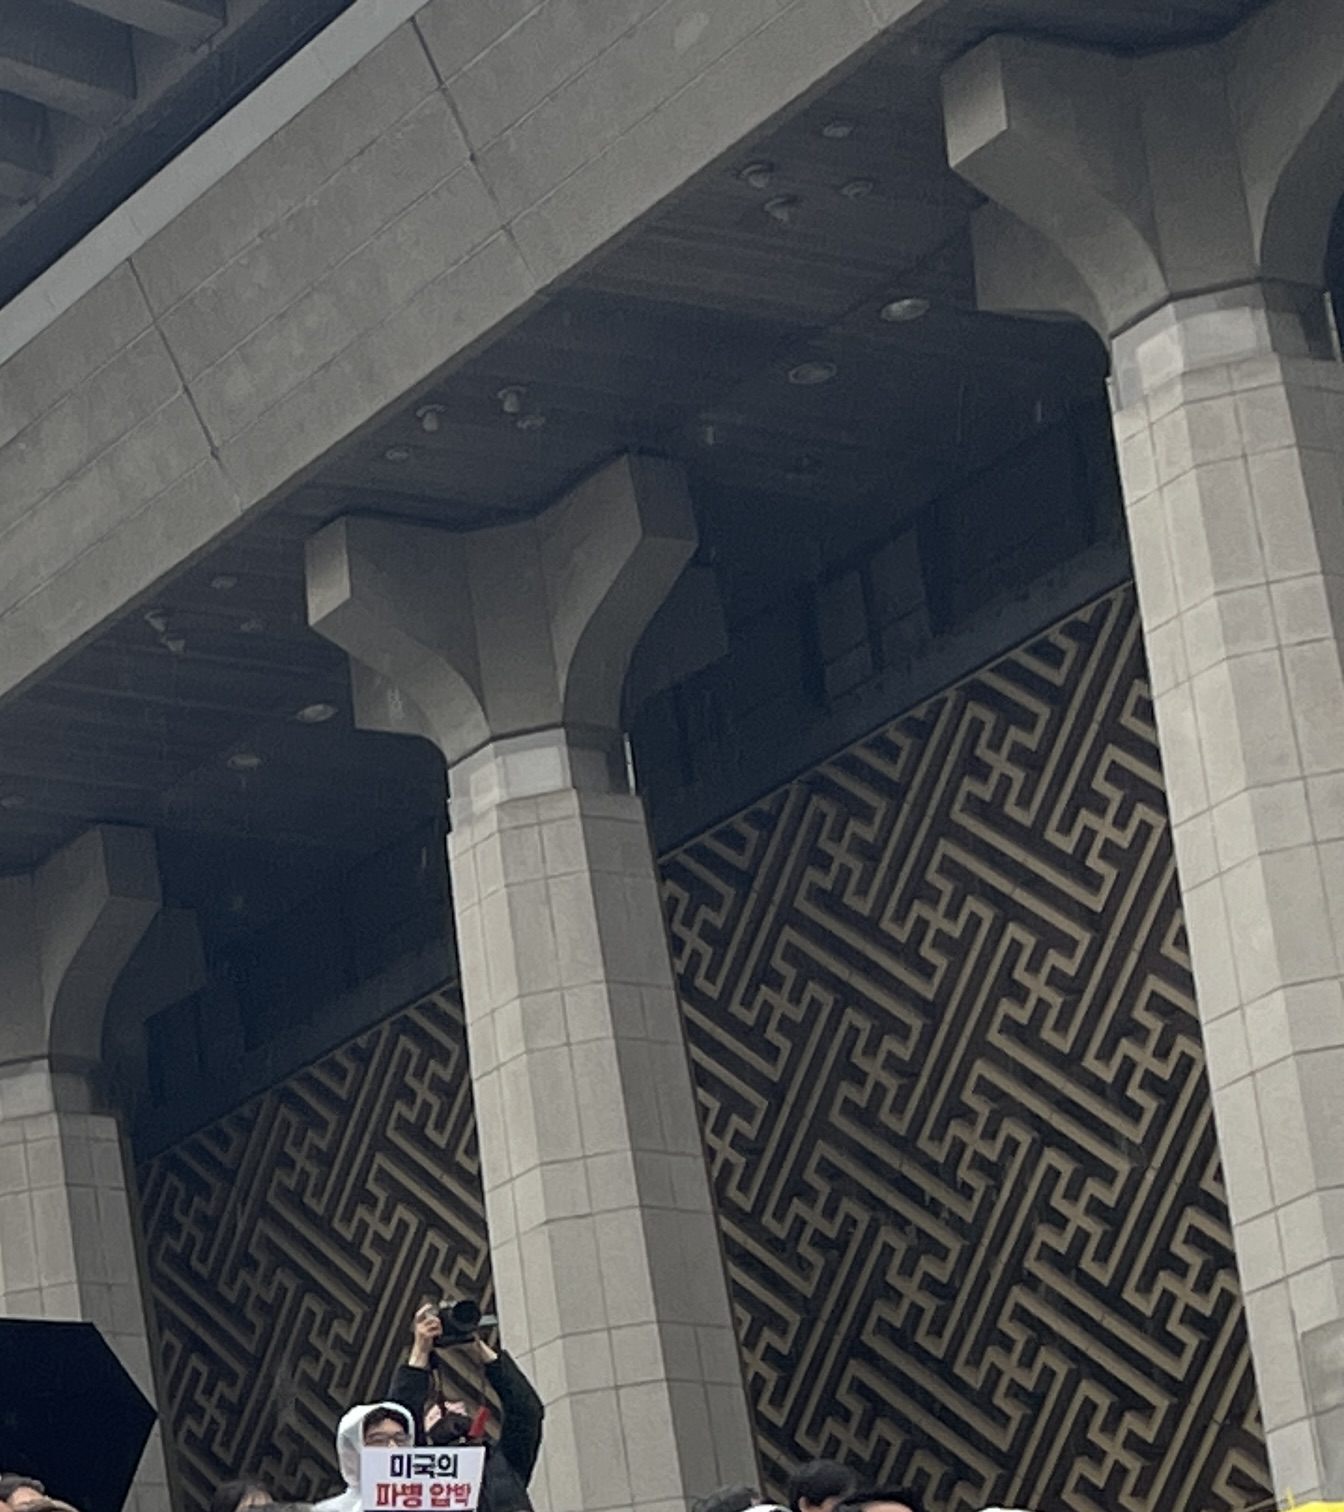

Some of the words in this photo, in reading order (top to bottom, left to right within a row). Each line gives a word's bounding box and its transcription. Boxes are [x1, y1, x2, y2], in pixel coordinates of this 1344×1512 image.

[390, 1453, 458, 1479] 미국의
[375, 1483, 422, 1508] 파병
[429, 1483, 471, 1507] 압박
